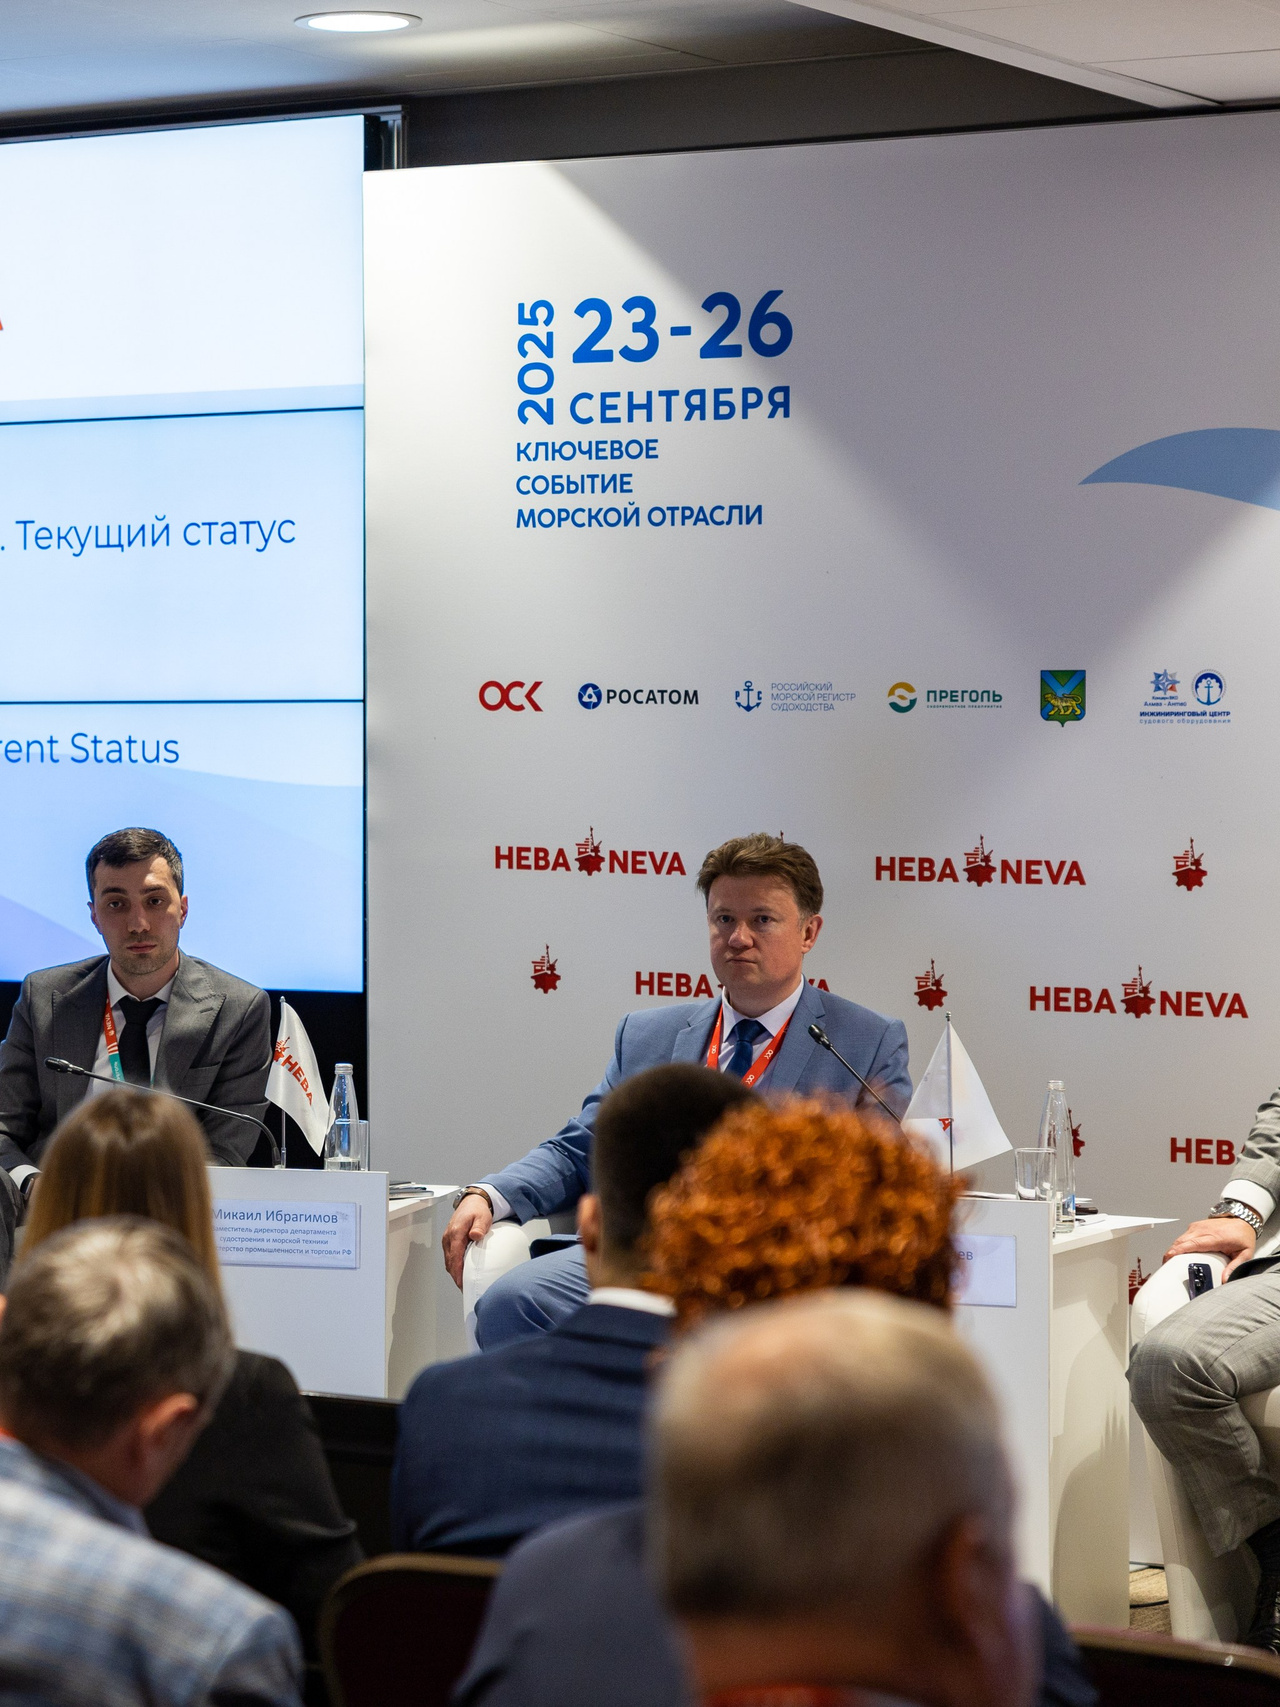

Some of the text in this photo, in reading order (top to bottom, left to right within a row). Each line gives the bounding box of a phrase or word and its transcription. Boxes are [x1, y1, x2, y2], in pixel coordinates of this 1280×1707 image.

[572, 289, 794, 364] 23-26
[517, 299, 555, 426] 2025
[570, 385, 791, 425] СЕНТЯБРЯ
[516, 439, 659, 462] КЛЮЧЕВОЕ
[516, 473, 633, 496] СОБЫТИЕ
[516, 502, 763, 529] МОРСКОЙ ОТРАСЛИ
[16, 516, 172, 557] Текущий
[183, 518, 297, 552] статус
[479, 681, 544, 712] ОСК
[606, 688, 699, 705] РОСАТОМ
[771, 682, 833, 691] РОССИЙСКИЙ
[771, 692, 856, 701] МОРСКОЙ РЕГИСТР
[926, 690, 1003, 703] ПРЕГОЛЬ
[771, 703, 835, 712] СУДОХОДСТВА
[70, 732, 180, 765] Status
[494, 846, 687, 876] НЕВА NEVA
[875, 856, 1087, 886] НЕВА NEVA
[635, 971, 714, 999] НЕВА
[1029, 985, 1249, 1019] НЕВА NEVA
[281, 1054, 313, 1106] НЕВА
[1170, 1137, 1245, 1166] НЕВ
[212, 1209, 338, 1224] Микаил Ибрагимов
[254, 1227, 289, 1235] директора
